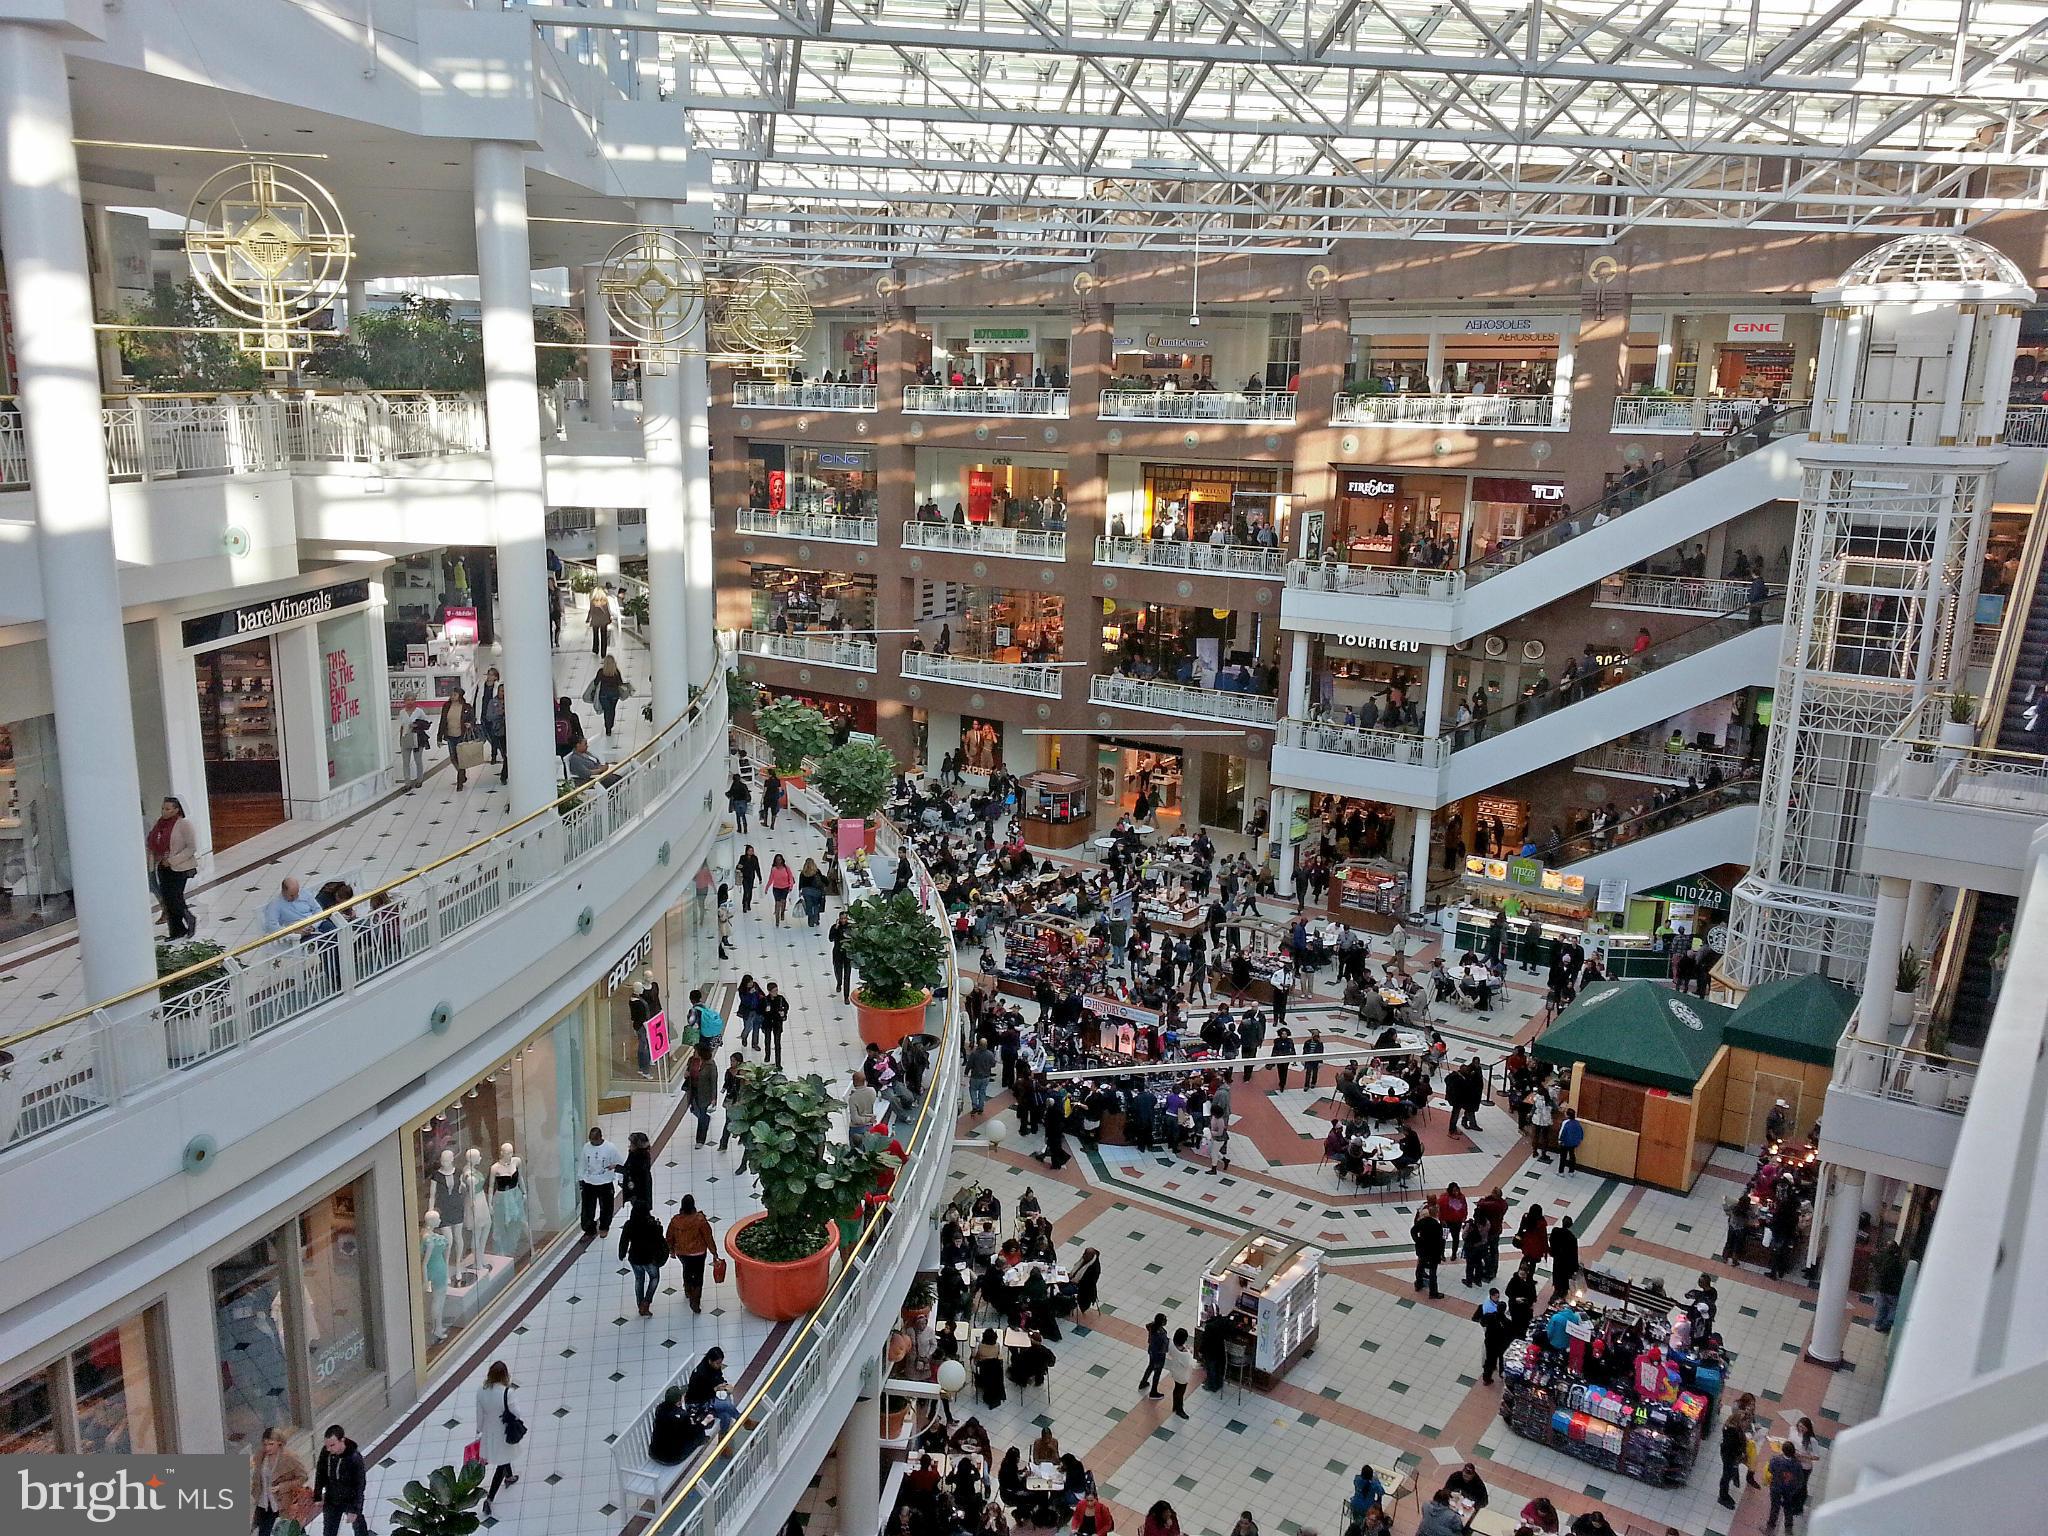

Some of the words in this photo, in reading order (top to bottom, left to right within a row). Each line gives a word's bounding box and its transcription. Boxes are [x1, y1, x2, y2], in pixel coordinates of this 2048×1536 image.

[1466, 320, 1531, 329] AEROSOLES
[1733, 323, 1779, 333] GNC
[820, 453, 860, 464] ICING
[236, 591, 332, 634] bareMinerals
[1337, 633, 1419, 653] TOURNEAU
[327, 649, 347, 671] THIS
[329, 670, 338, 690] IS
[340, 665, 355, 684] THE
[330, 686, 347, 707] END
[331, 704, 342, 724] OF
[344, 699, 360, 720] THE
[332, 720, 352, 741] LINE
[1675, 884, 1722, 903] mozza
[1092, 1001, 1119, 1015] HISTORY
[655, 1021, 664, 1051] 5
